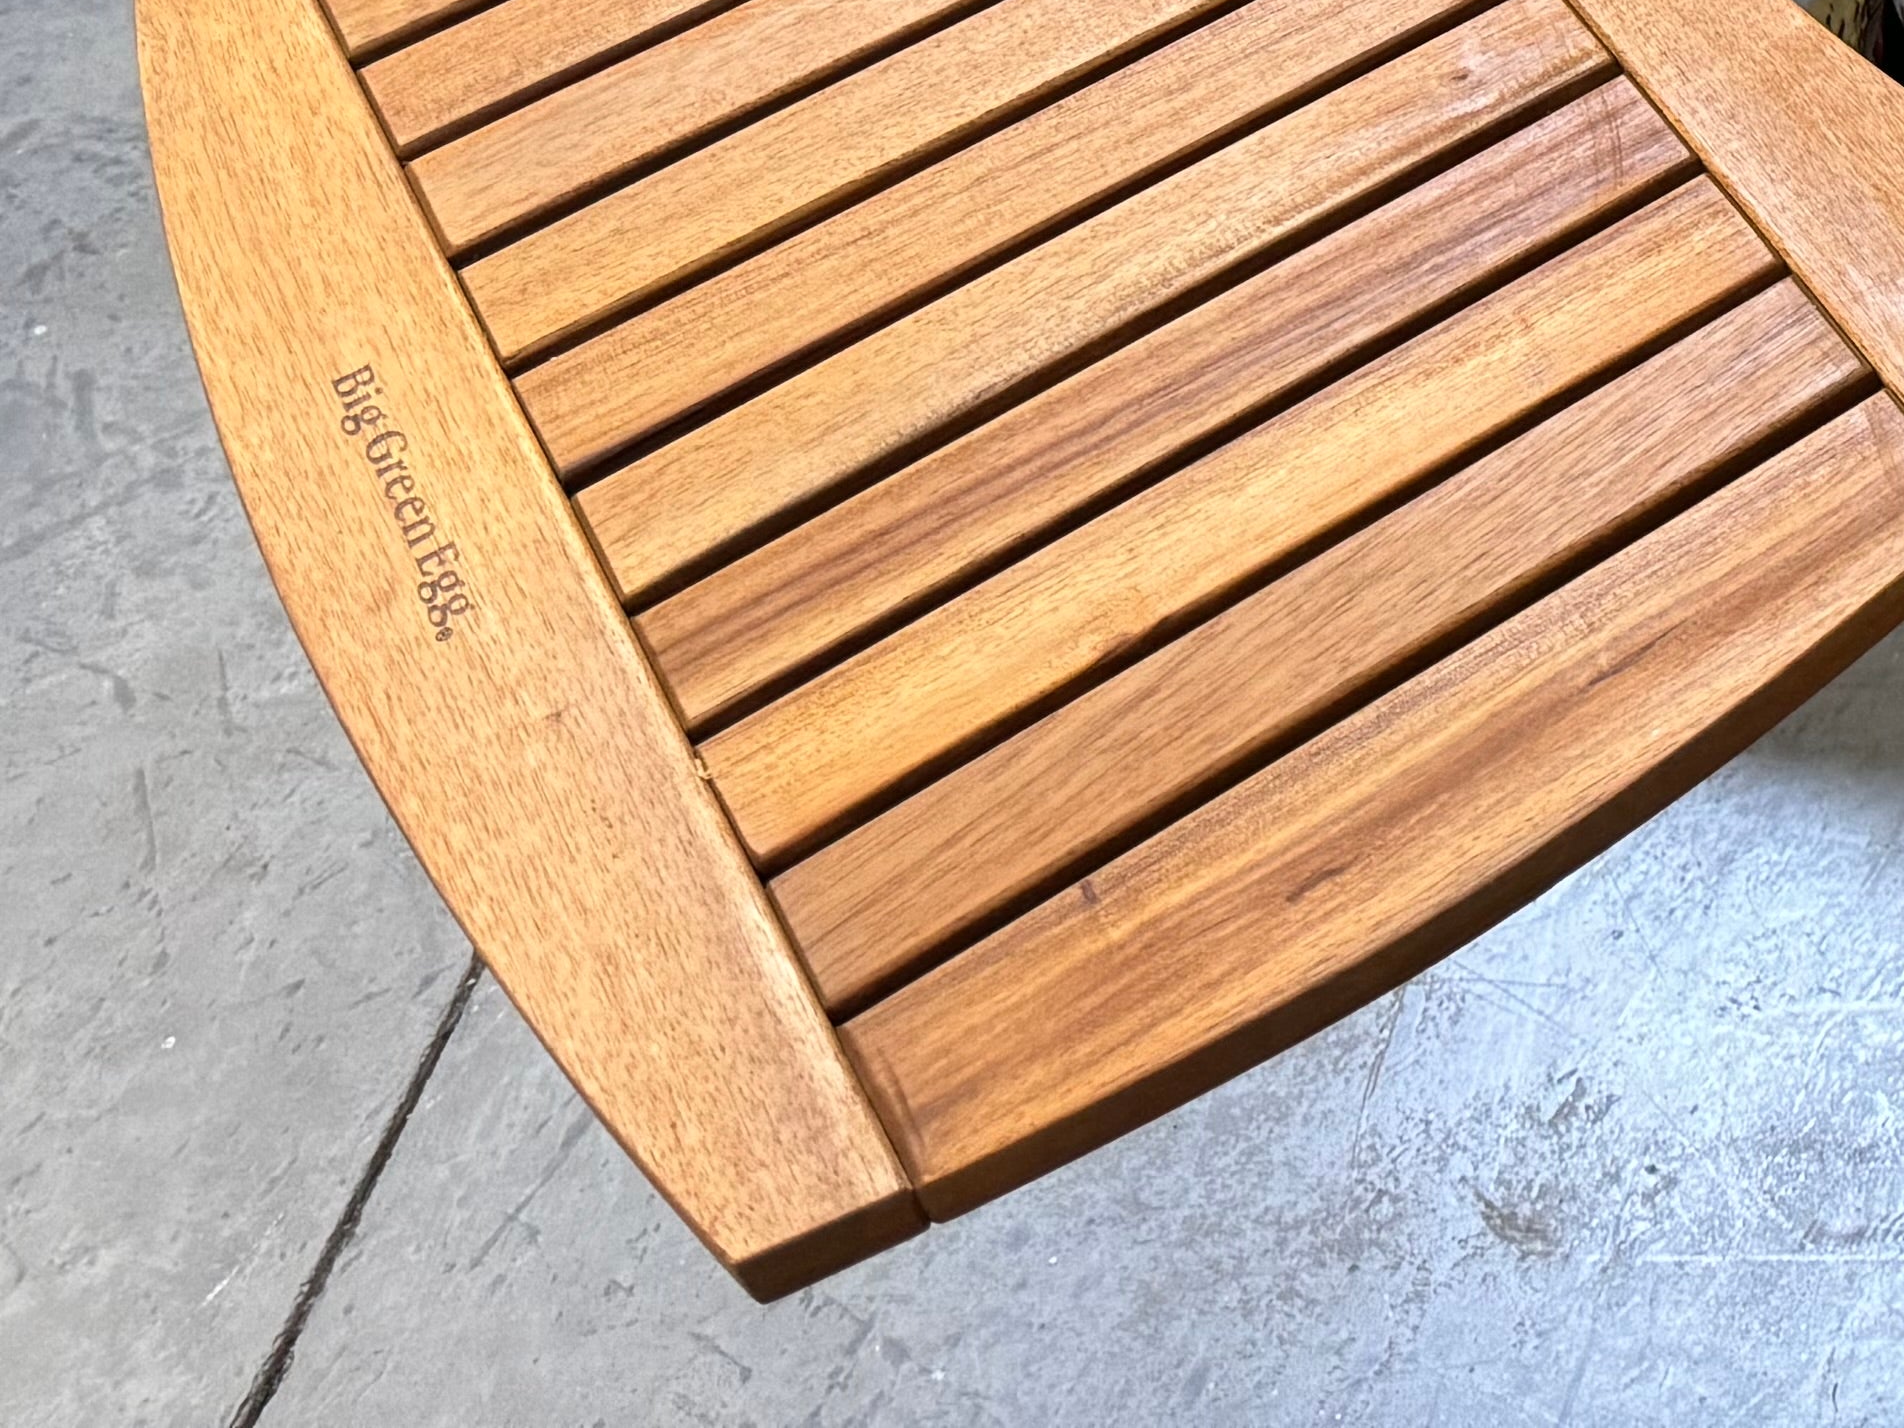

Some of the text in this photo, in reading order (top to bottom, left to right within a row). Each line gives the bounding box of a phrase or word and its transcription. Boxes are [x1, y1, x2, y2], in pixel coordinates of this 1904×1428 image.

[331, 363, 475, 628] Big Green Egg
